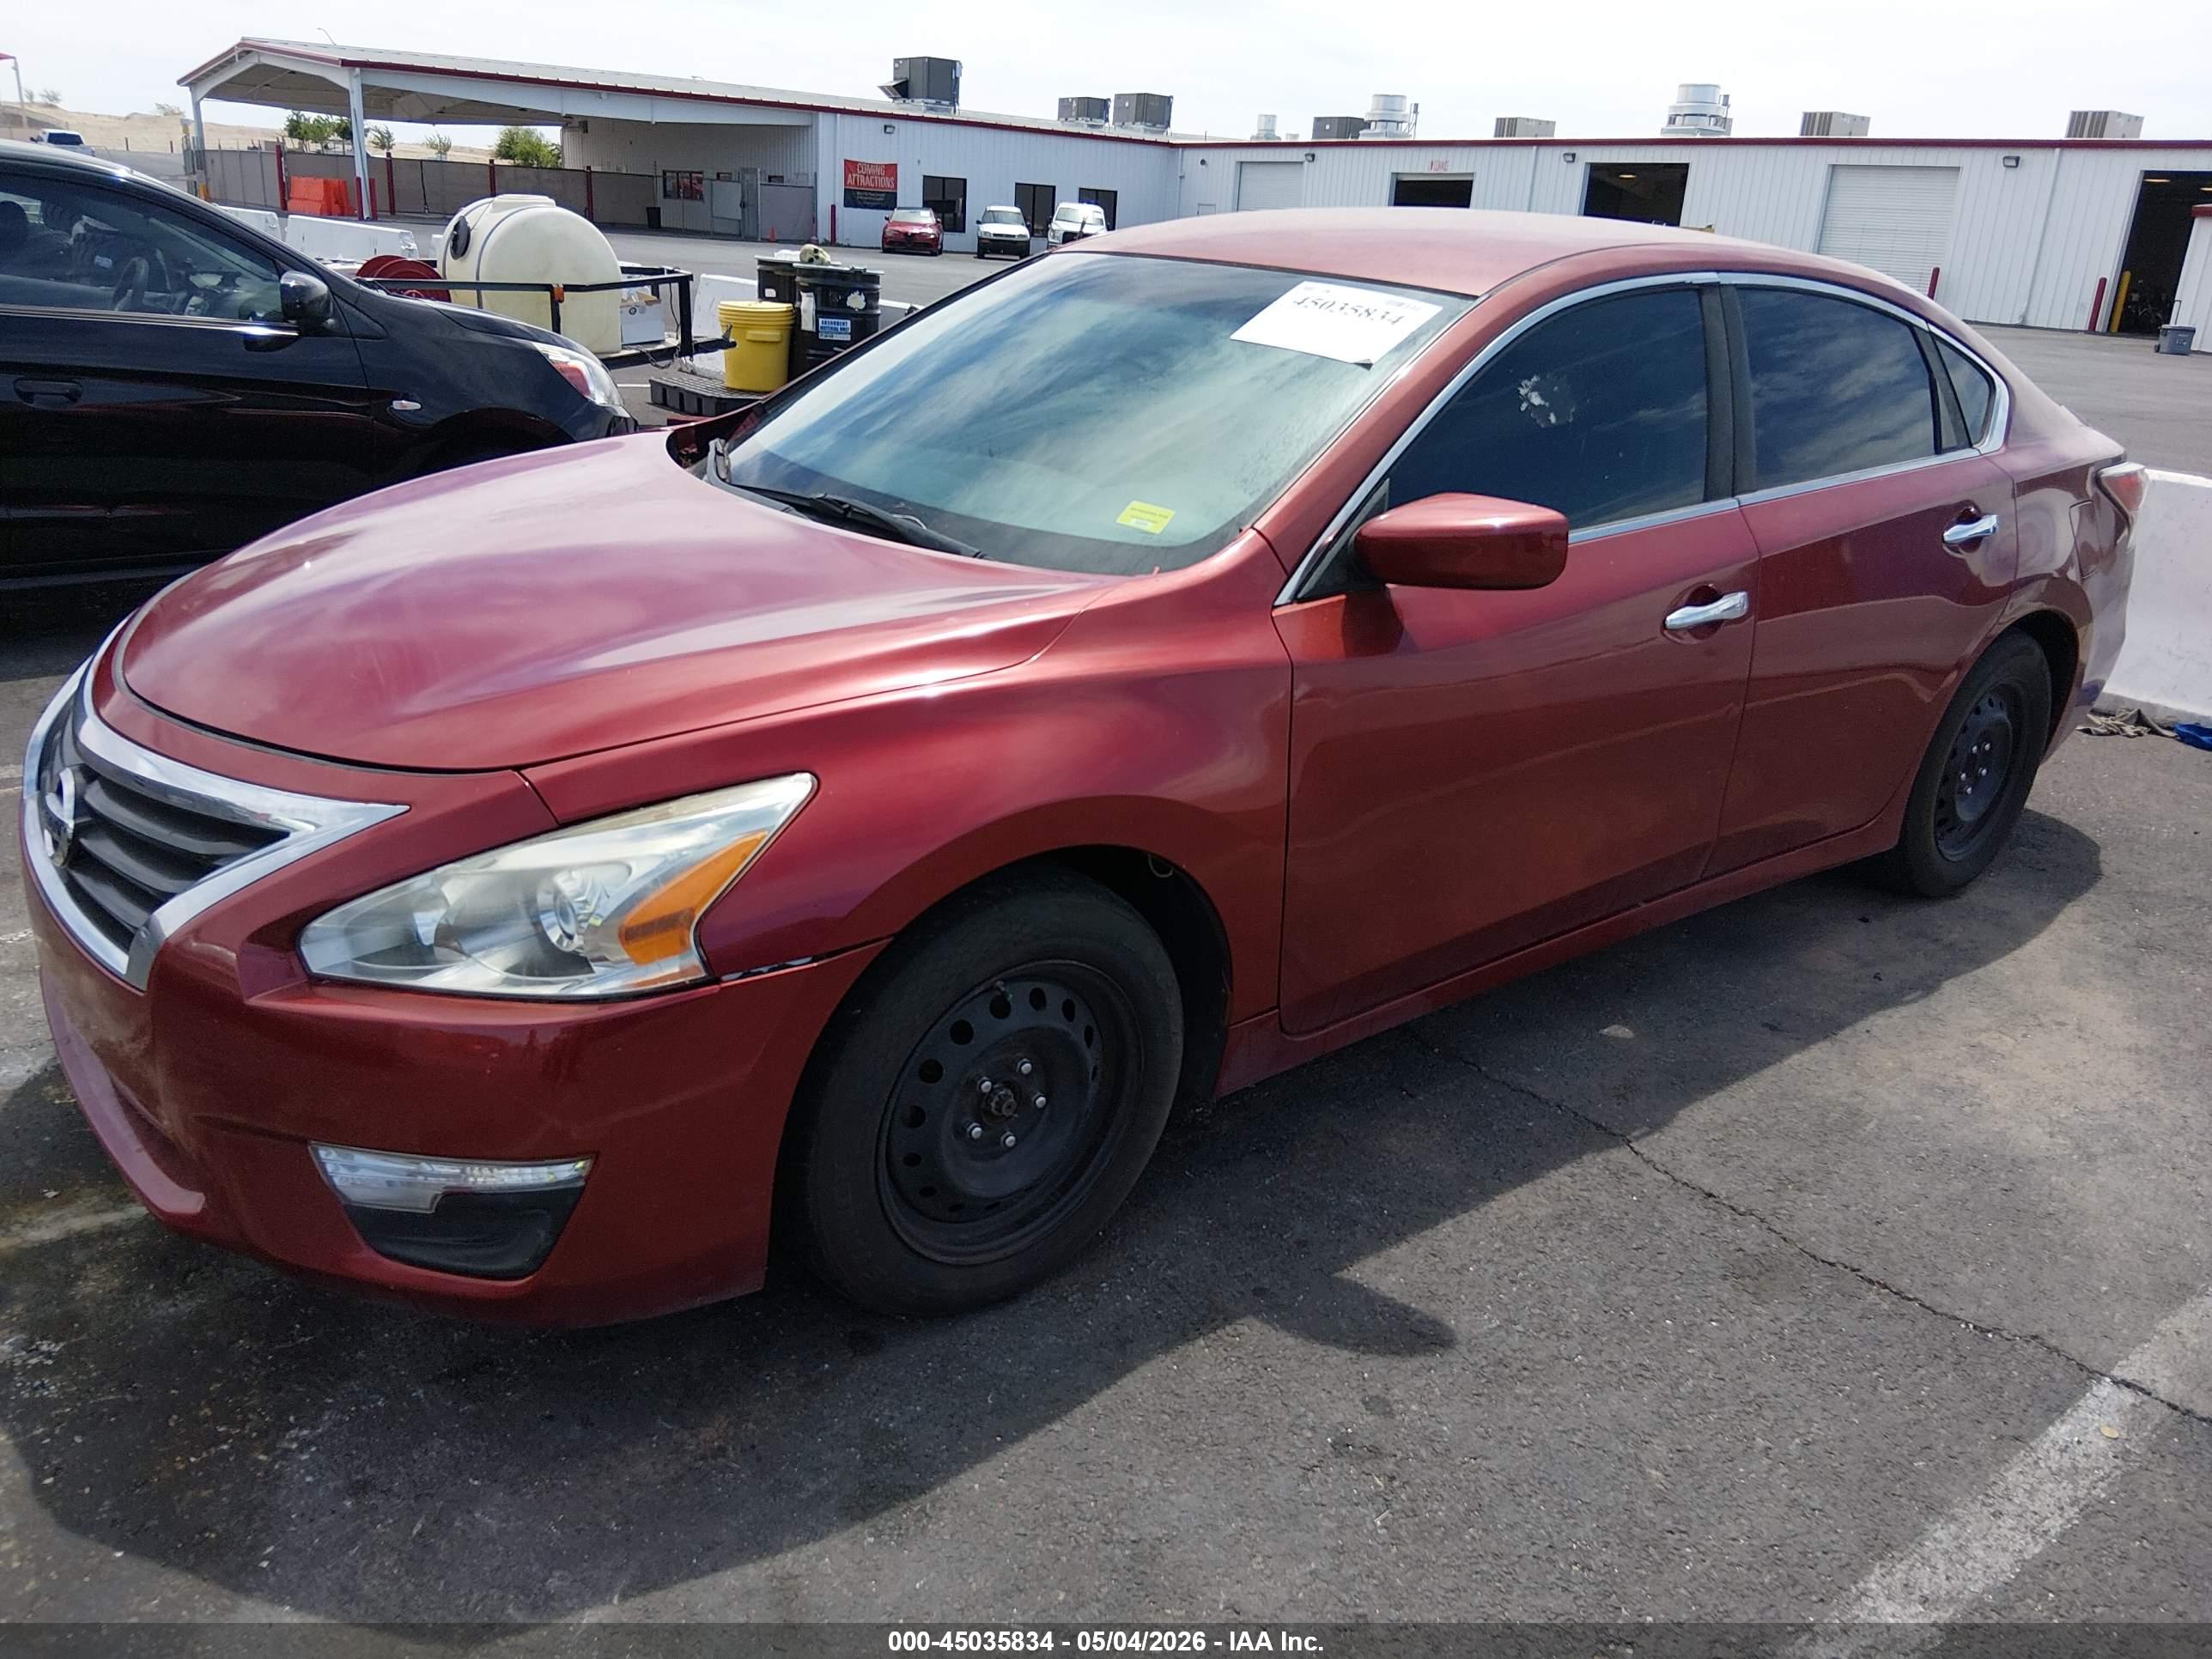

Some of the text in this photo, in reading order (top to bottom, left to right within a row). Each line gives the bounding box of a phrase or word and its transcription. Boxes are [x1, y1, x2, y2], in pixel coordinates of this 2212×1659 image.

[857, 163, 885, 176] COMING
[847, 173, 895, 189] ATTRACTIONS
[1293, 296, 1405, 325] 45035834
